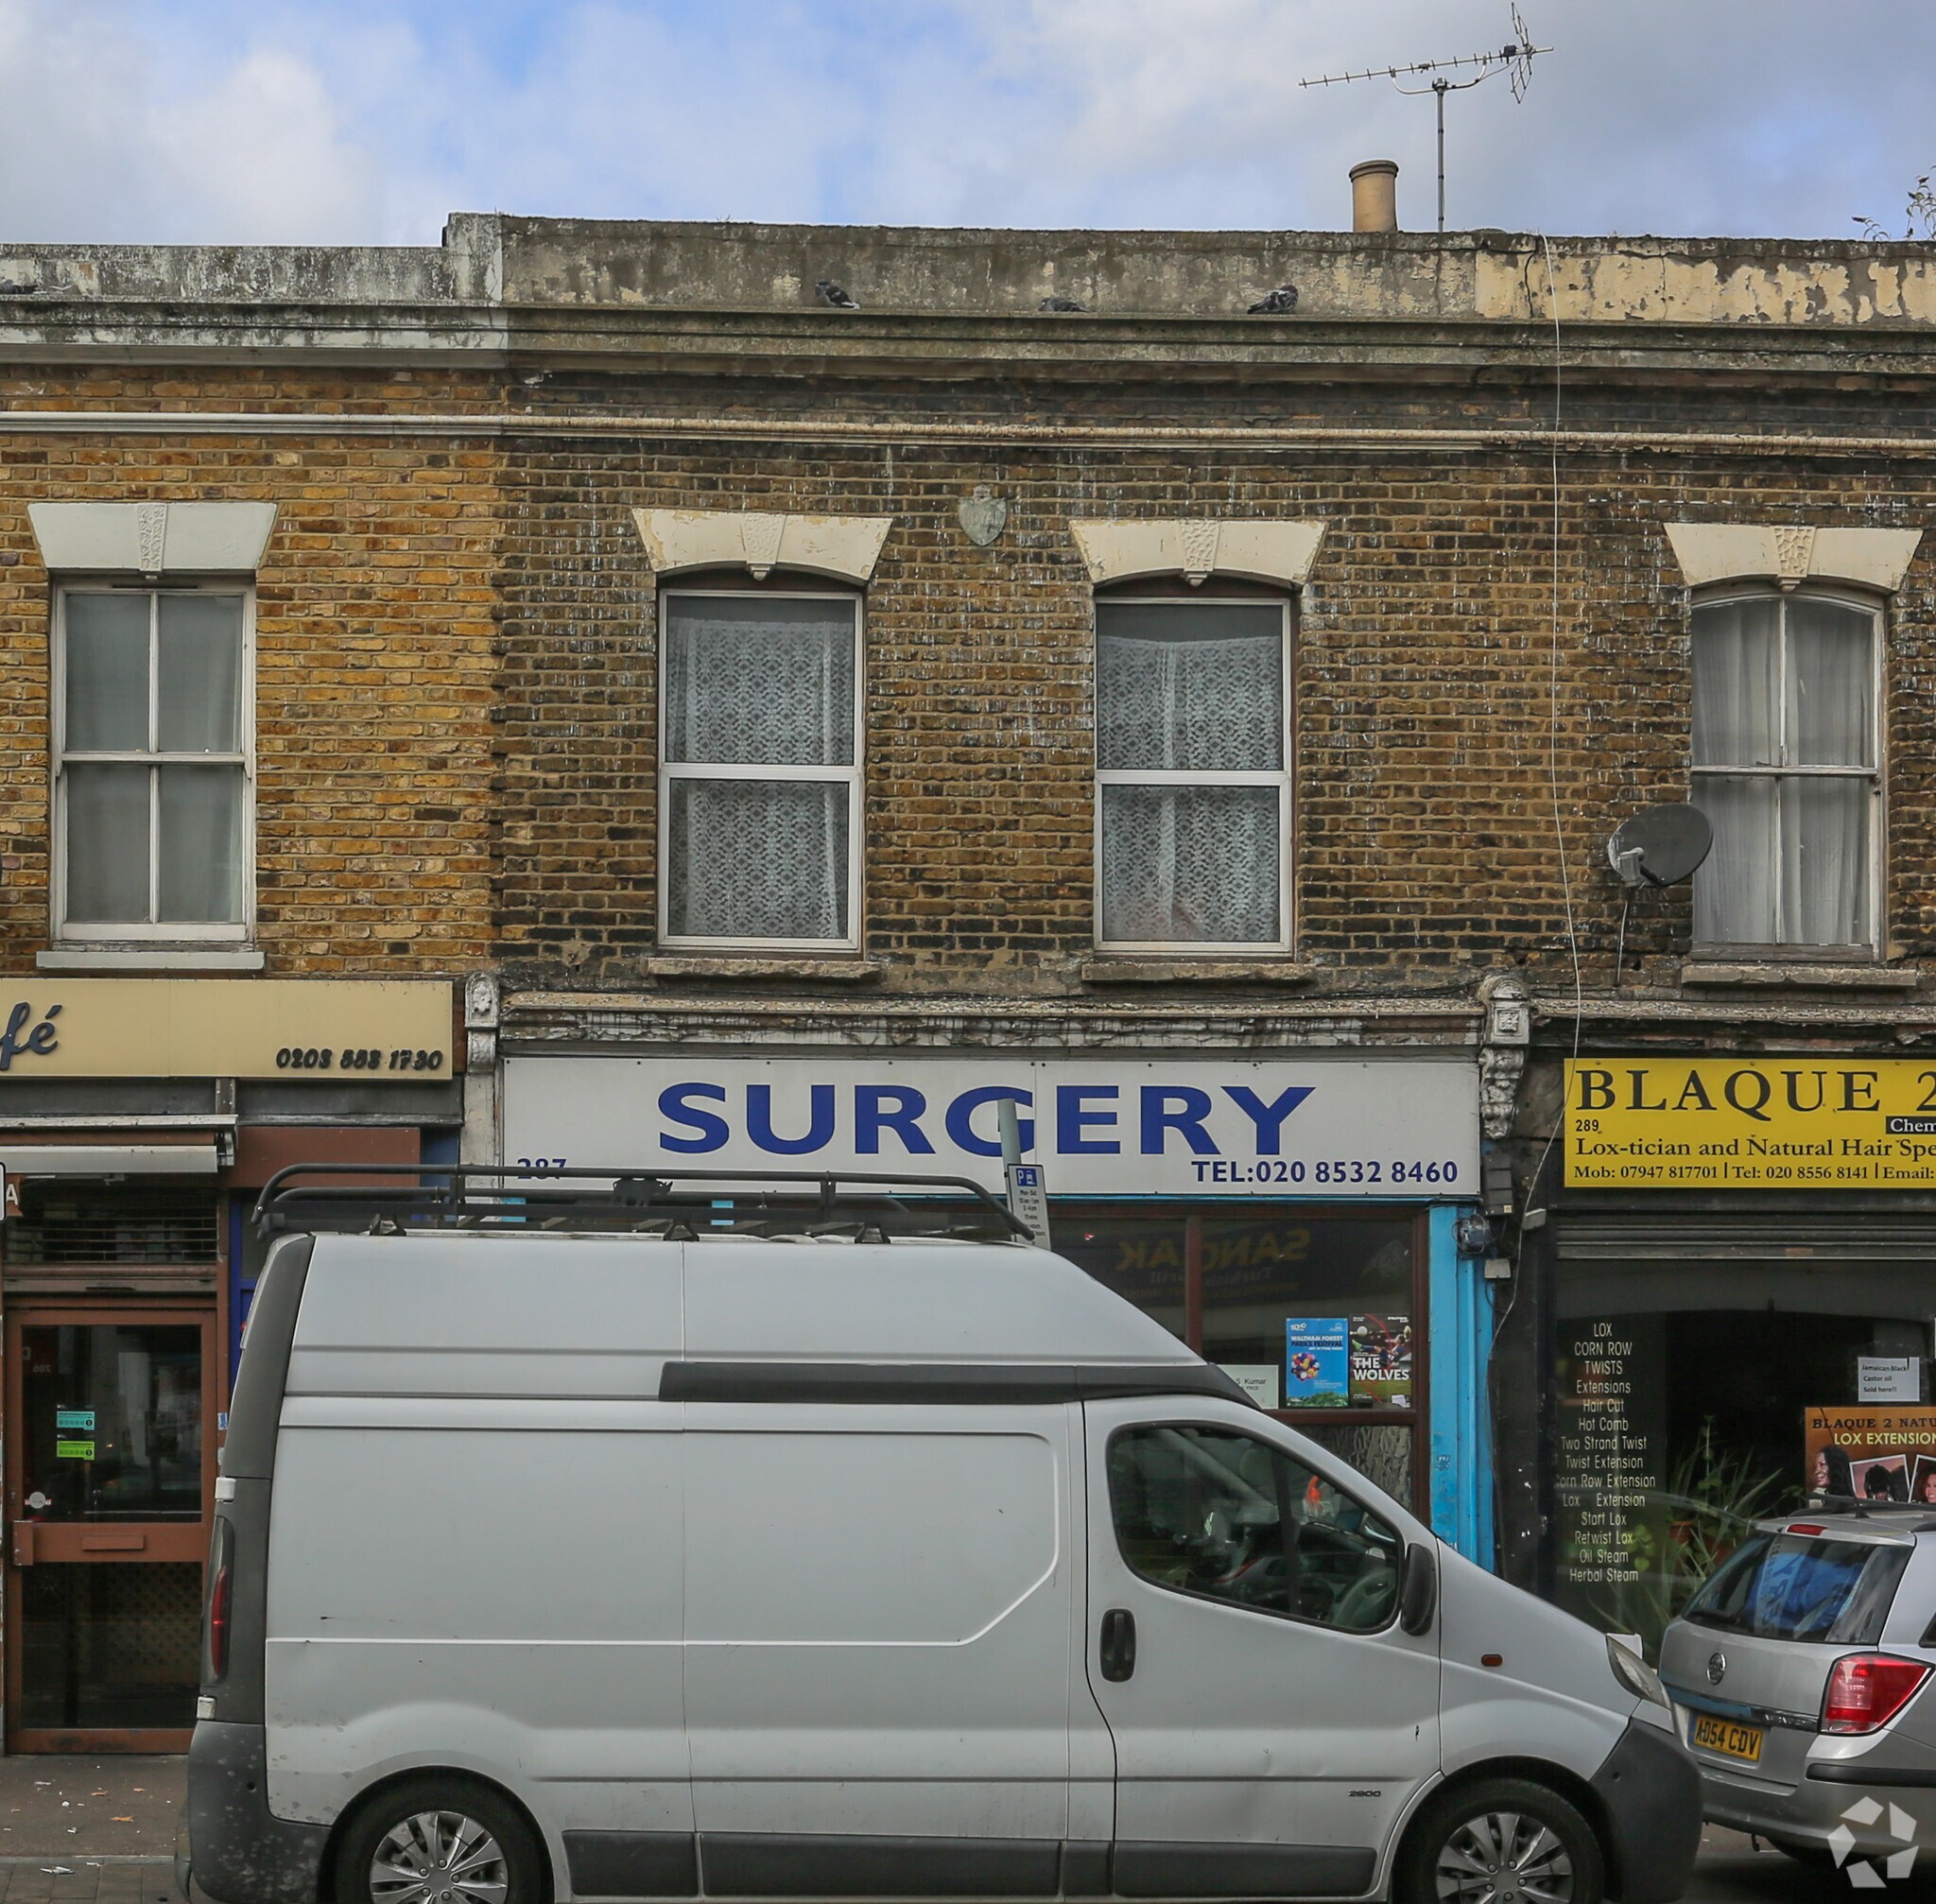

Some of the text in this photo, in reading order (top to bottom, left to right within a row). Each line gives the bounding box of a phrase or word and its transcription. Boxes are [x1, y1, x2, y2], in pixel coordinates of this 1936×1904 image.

[389, 1049, 442, 1070] 1730
[1575, 1069, 1936, 1121] BLAQUE 2
[658, 1082, 1316, 1157] SURGERY
[1575, 1118, 1599, 1133] 289
[1575, 1137, 1691, 1156] Lox-tician
[1699, 1137, 1739, 1156] and
[1746, 1137, 1833, 1156] Natural
[1841, 1138, 1893, 1156] Hair
[1315, 1161, 1382, 1183] 8532
[1392, 1162, 1459, 1183] 8460
[1574, 1165, 1935, 1179] Mob: 07947 817701 Tel: 020 8556 8141 Email:
[1593, 1323, 1613, 1337] LOX
[1574, 1341, 1633, 1356] CORN ROW
[1353, 1357, 1380, 1369] THE
[1584, 1360, 1623, 1375] TWISTS
[1353, 1369, 1409, 1380] WOLVES
[1576, 1379, 1631, 1393] Extensions
[1582, 1398, 1624, 1412] Hair Cut
[1579, 1417, 1629, 1431] Hot Comb
[1812, 1418, 1876, 1430] BLAQUE
[1883, 1418, 1893, 1428] 2
[1561, 1435, 1647, 1450] Two Strand Twist
[1834, 1432, 1862, 1445] LOX
[1565, 1454, 1643, 1469] Twist Extension
[1581, 1474, 1602, 1488] Row
[1607, 1473, 1655, 1488] Extension
[1563, 1493, 1645, 1507] Lox Extension
[1582, 1512, 1627, 1526] Start Lox
[1575, 1531, 1634, 1545] Retwist Lox
[1580, 1549, 1629, 1564] Oil Steam
[1569, 1567, 1638, 1582] Herbal Steam
[1728, 1727, 1759, 1756] CDV
